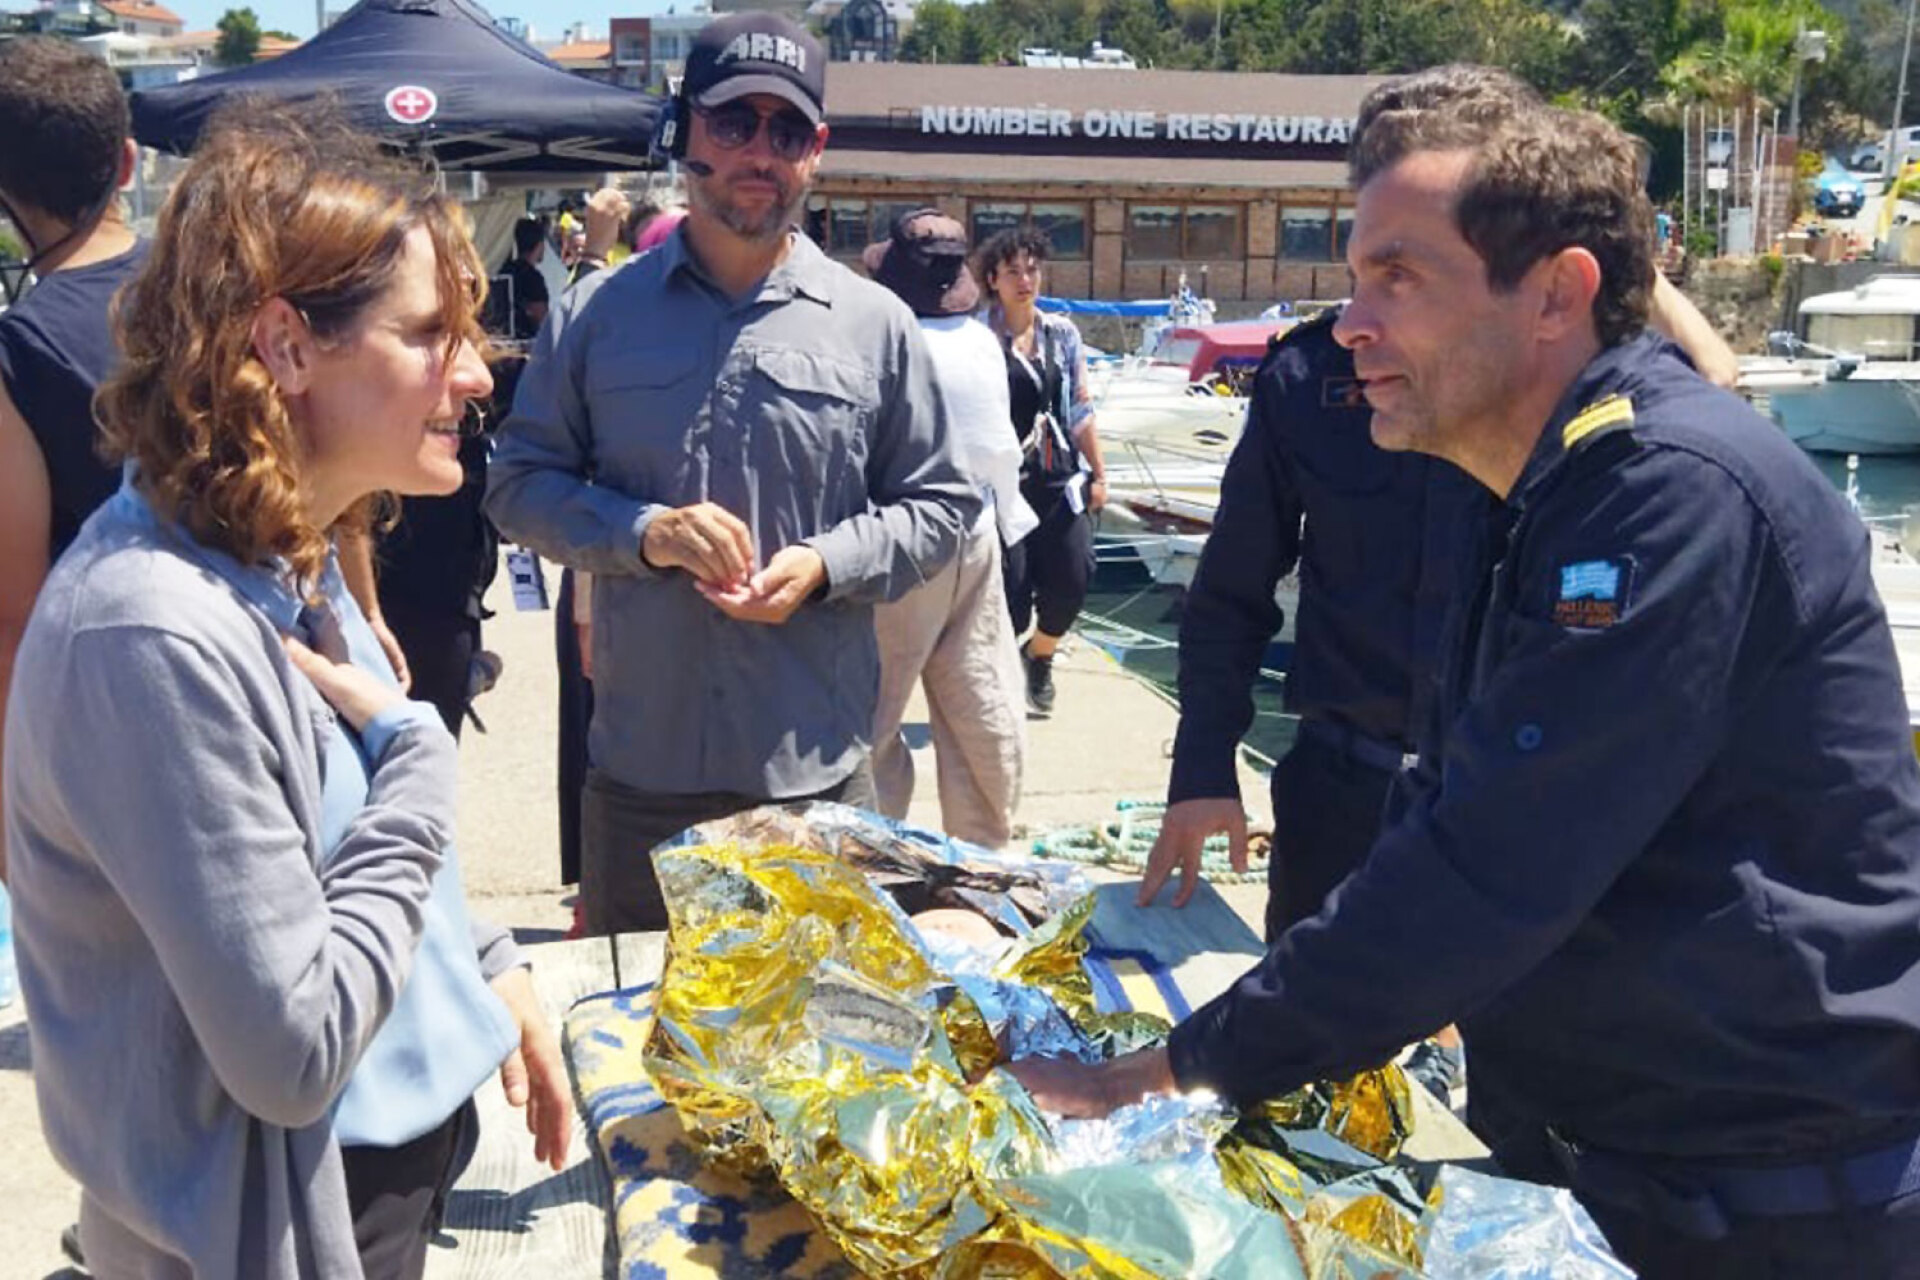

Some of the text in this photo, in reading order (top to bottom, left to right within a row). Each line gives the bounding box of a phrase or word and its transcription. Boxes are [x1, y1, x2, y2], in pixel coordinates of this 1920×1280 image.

[714, 32, 806, 73] ARRI
[921, 105, 1072, 137] NUMBER
[1082, 109, 1157, 138] ONE
